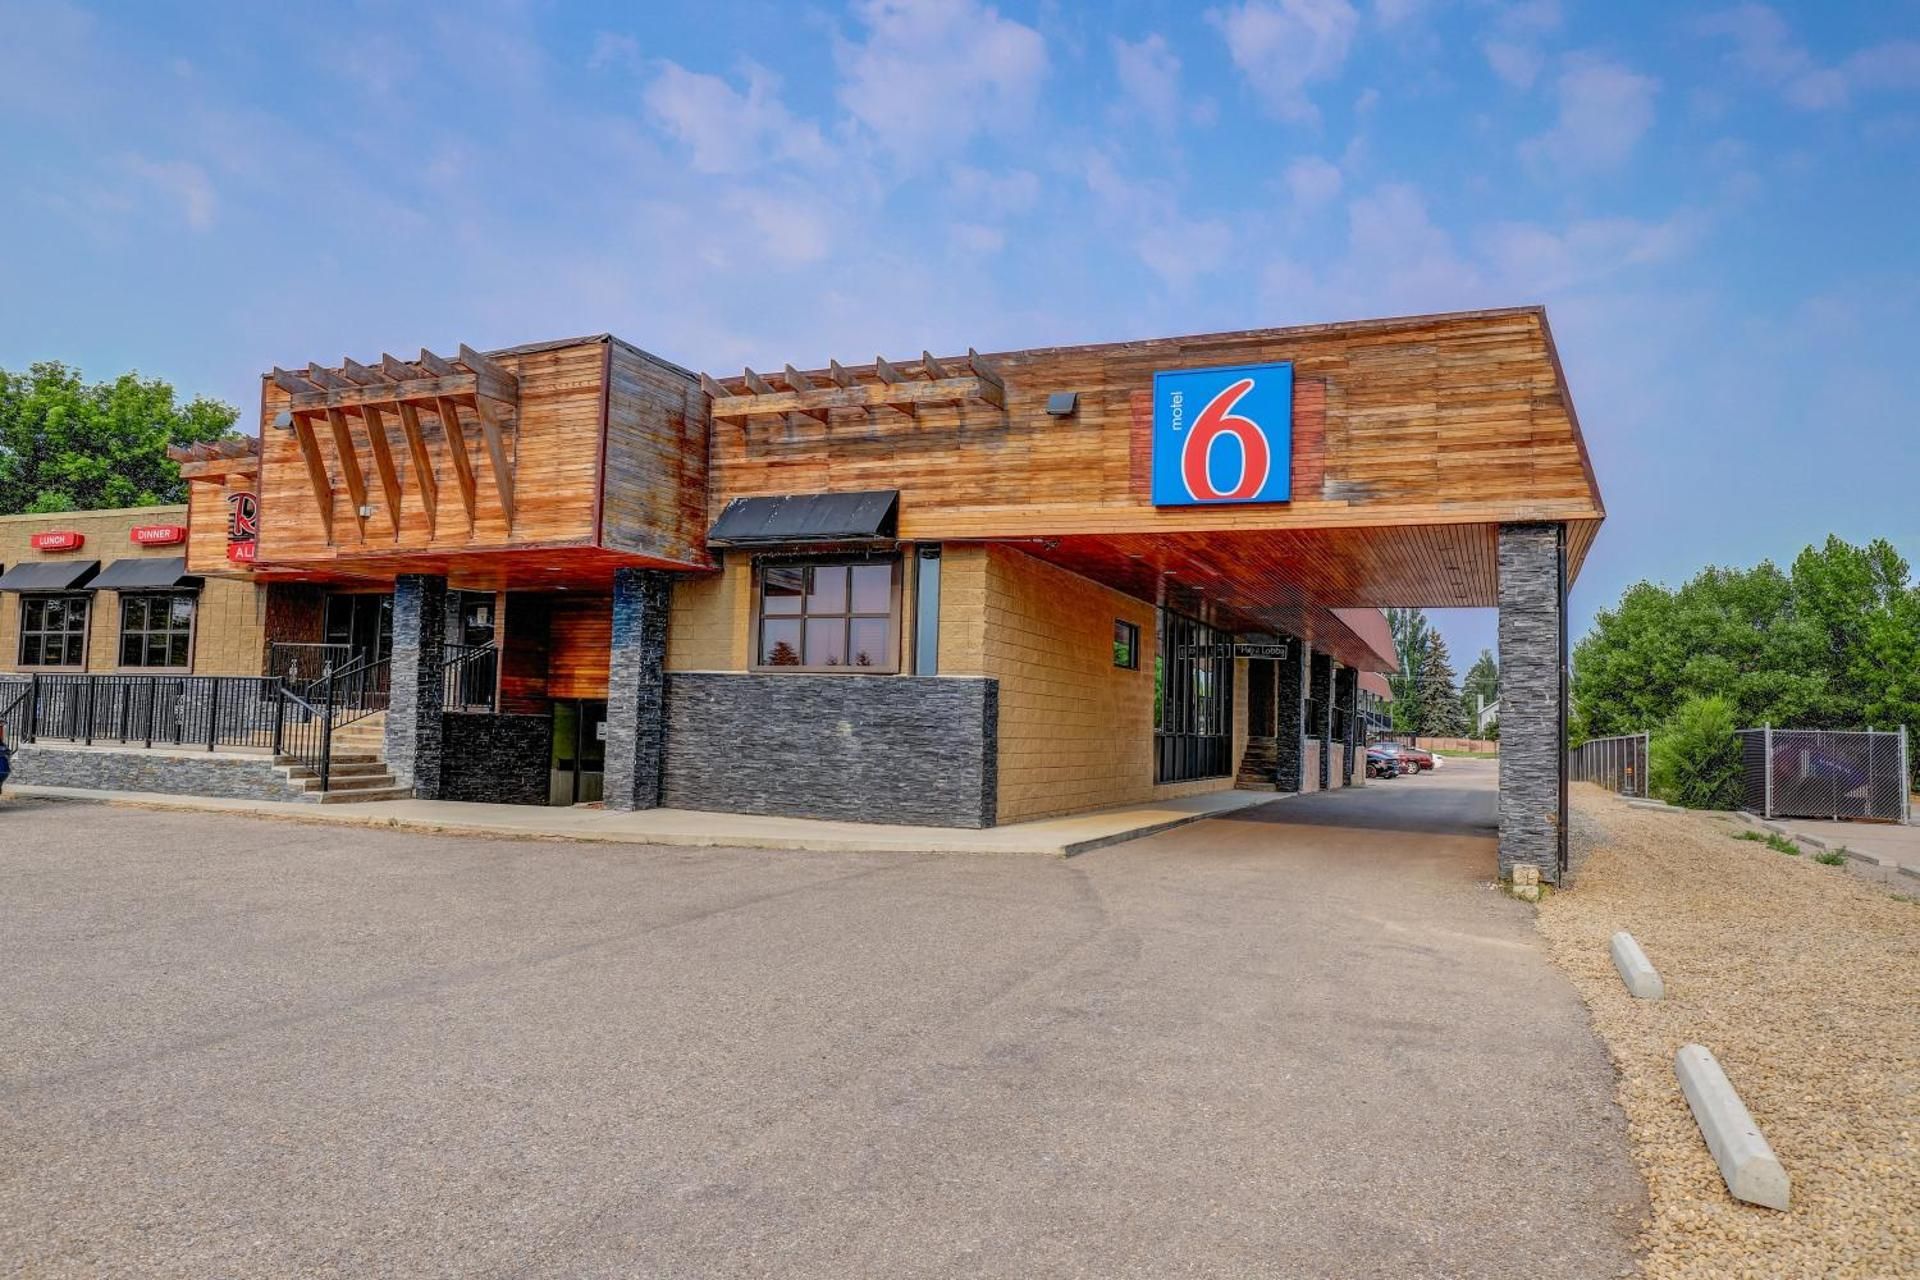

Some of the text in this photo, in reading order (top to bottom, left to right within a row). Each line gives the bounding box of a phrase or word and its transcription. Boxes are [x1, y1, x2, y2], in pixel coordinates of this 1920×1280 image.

[1170, 378, 1271, 501] motel 6
[38, 535, 66, 546] LUNCH
[137, 529, 172, 541] DINNER
[1262, 645, 1285, 658] Lobby
